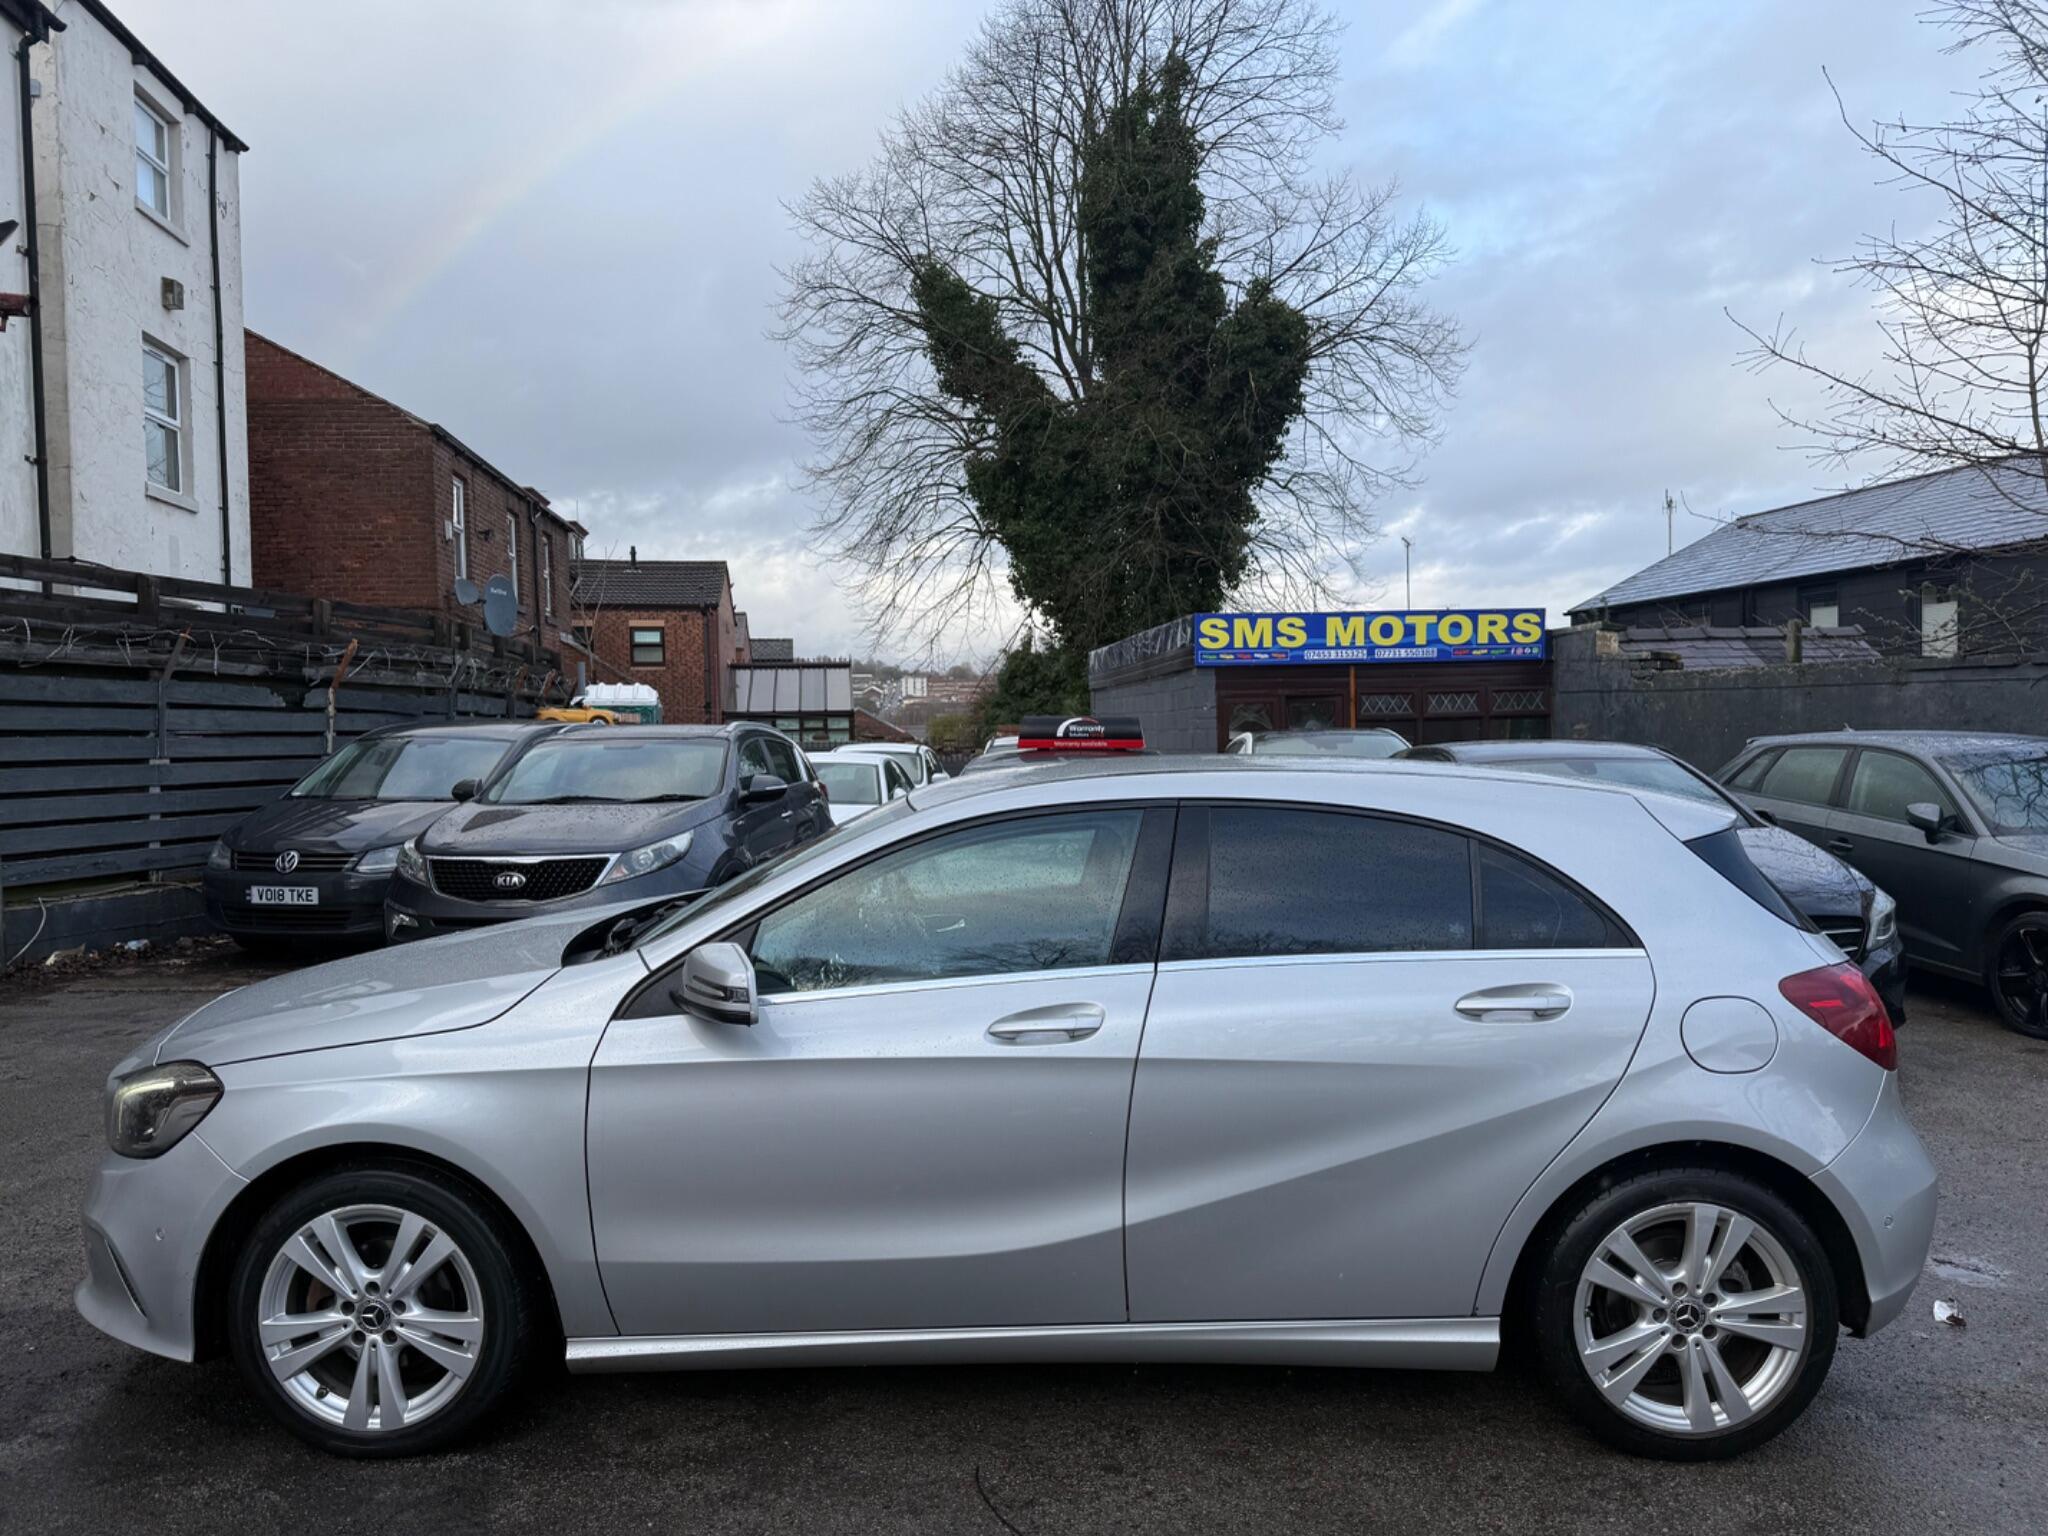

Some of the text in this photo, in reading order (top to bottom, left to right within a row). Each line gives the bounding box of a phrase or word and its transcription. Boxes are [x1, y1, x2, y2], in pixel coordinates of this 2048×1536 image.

[1199, 613, 1542, 649] SMS MOTORS
[1069, 724, 1105, 734] Warranty
[496, 874, 520, 888] KIA
[256, 888, 313, 902] VO18 TKE
